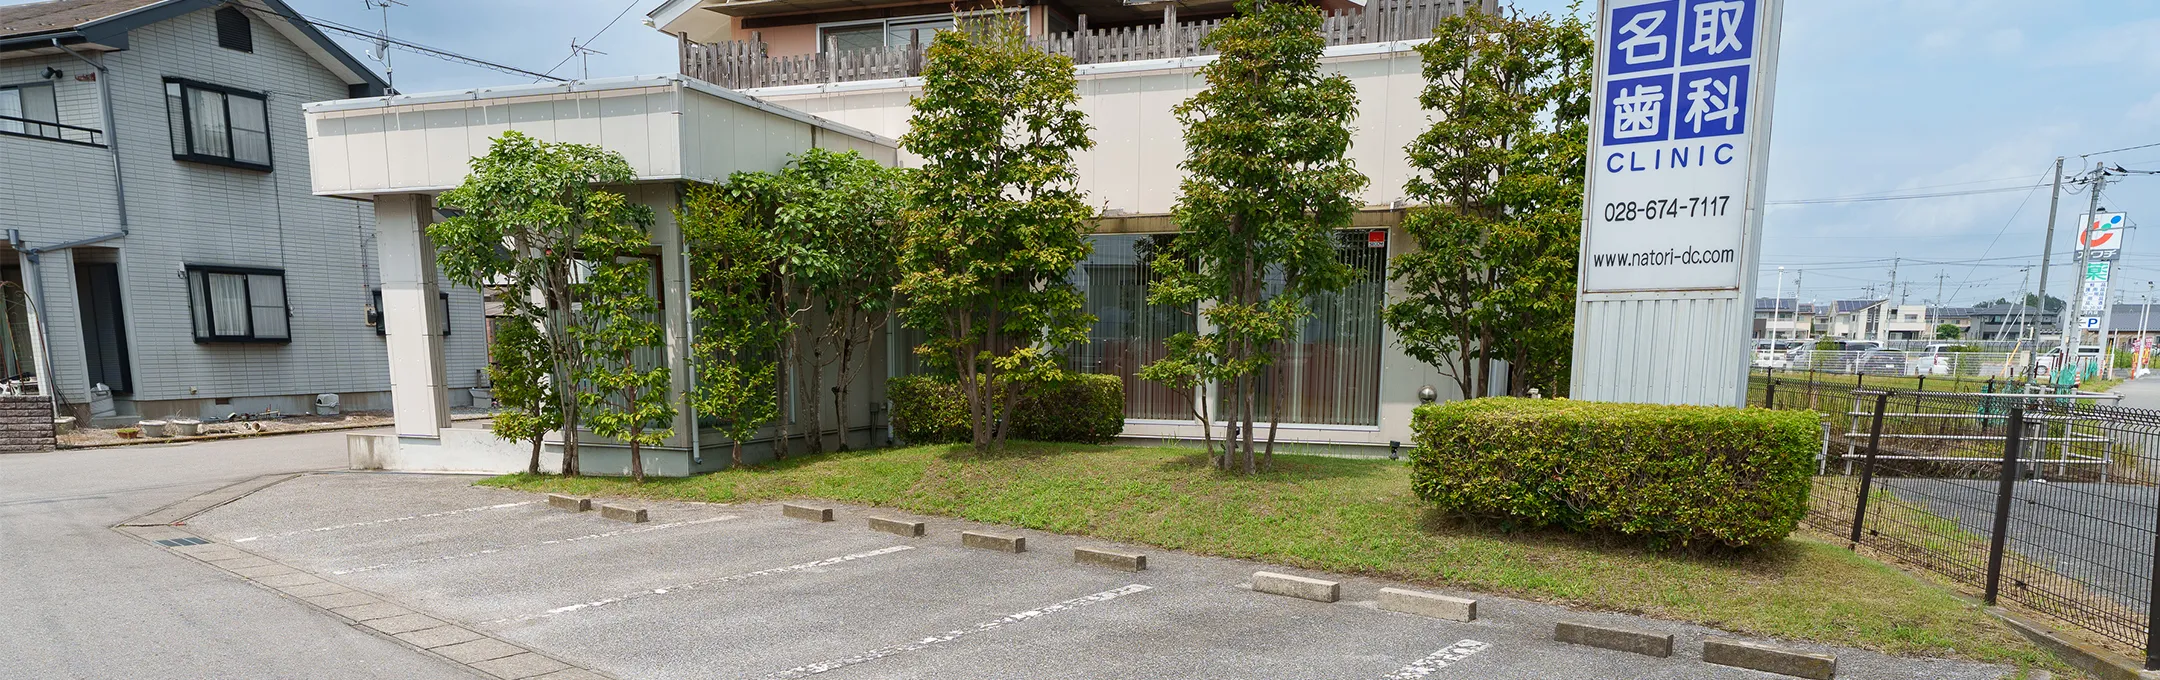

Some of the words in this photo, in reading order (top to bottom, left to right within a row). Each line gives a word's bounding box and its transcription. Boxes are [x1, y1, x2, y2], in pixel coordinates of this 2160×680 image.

[1617, 1, 1745, 65] 名取
[1612, 75, 1739, 139] 歯科
[1606, 143, 1734, 174] CLINIC
[1604, 195, 1730, 222] 028-674-7117
[1593, 245, 1734, 268] www.natori-dc.com
[2086, 263, 2108, 280] 薬
[2087, 318, 2098, 328] P
